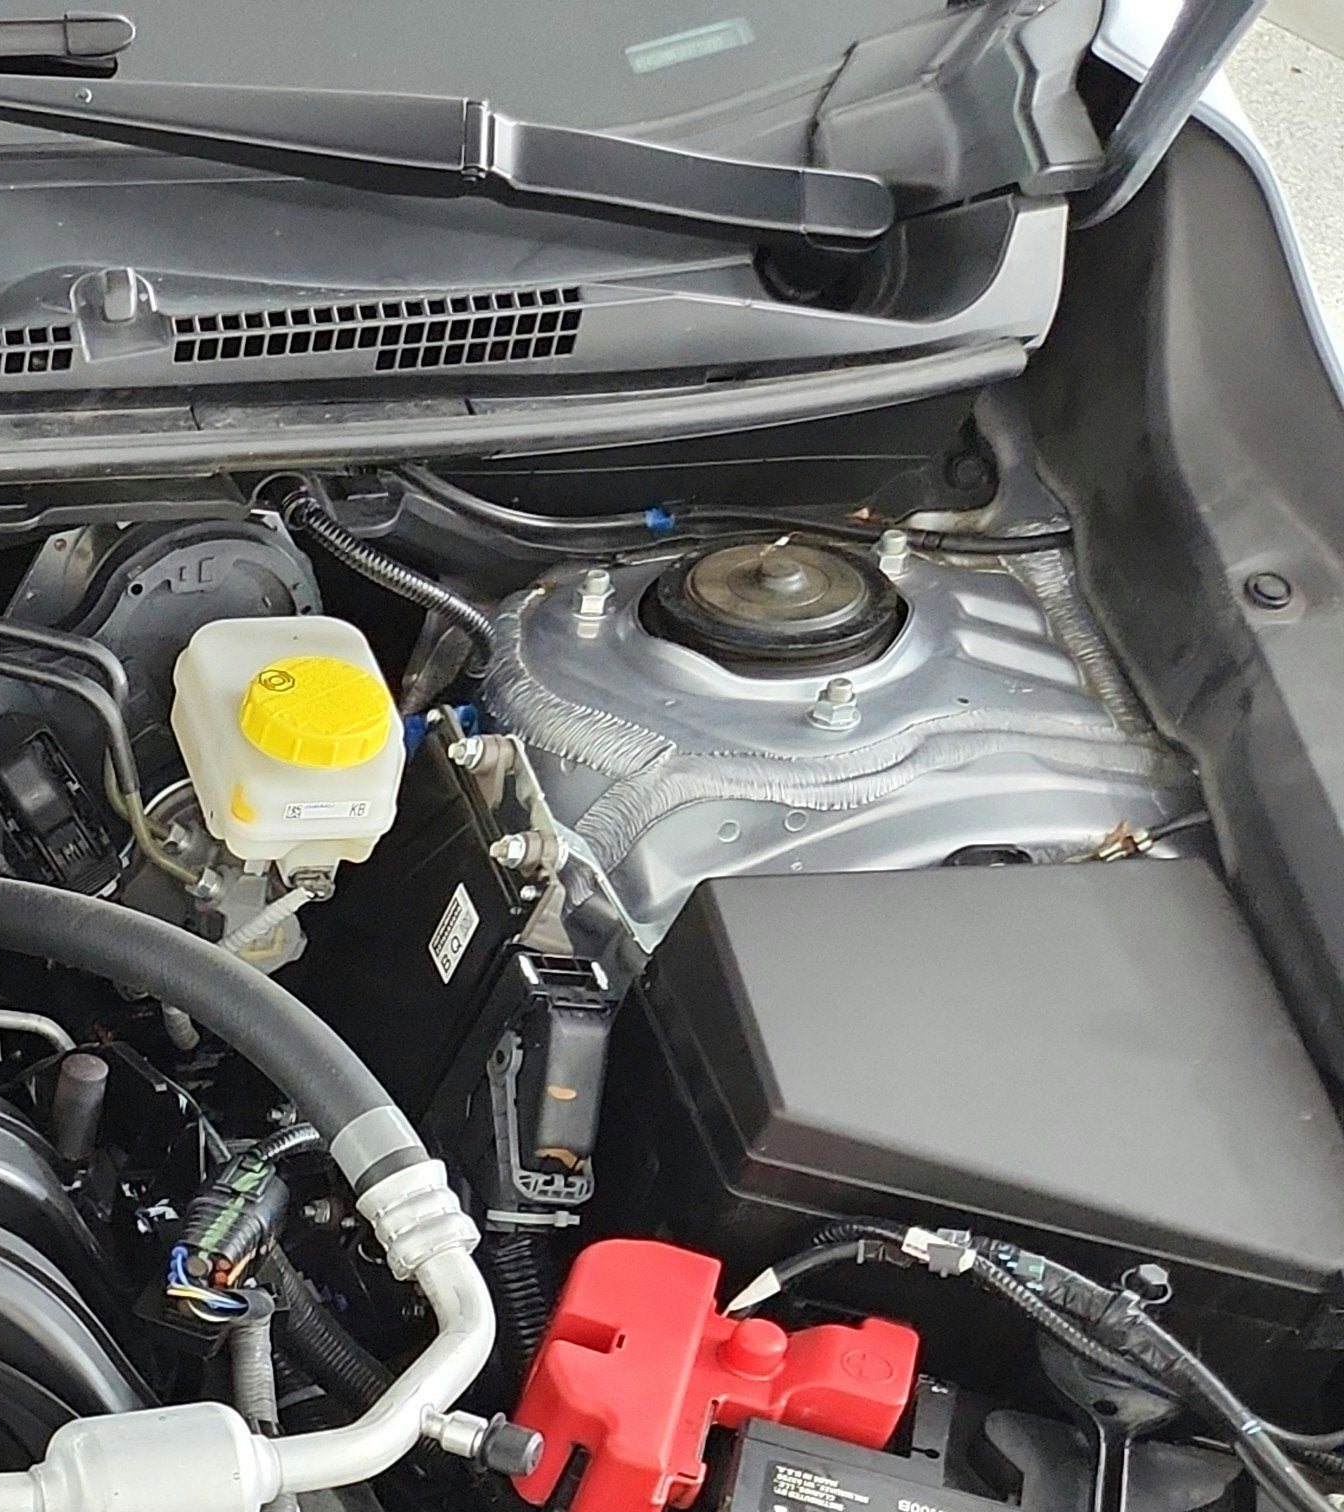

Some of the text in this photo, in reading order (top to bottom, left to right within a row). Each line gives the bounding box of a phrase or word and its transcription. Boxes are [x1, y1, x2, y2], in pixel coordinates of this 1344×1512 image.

[349, 803, 366, 816] KB
[775, 1465, 802, 1478] U.S.A.
[813, 1475, 839, 1488] MADE
